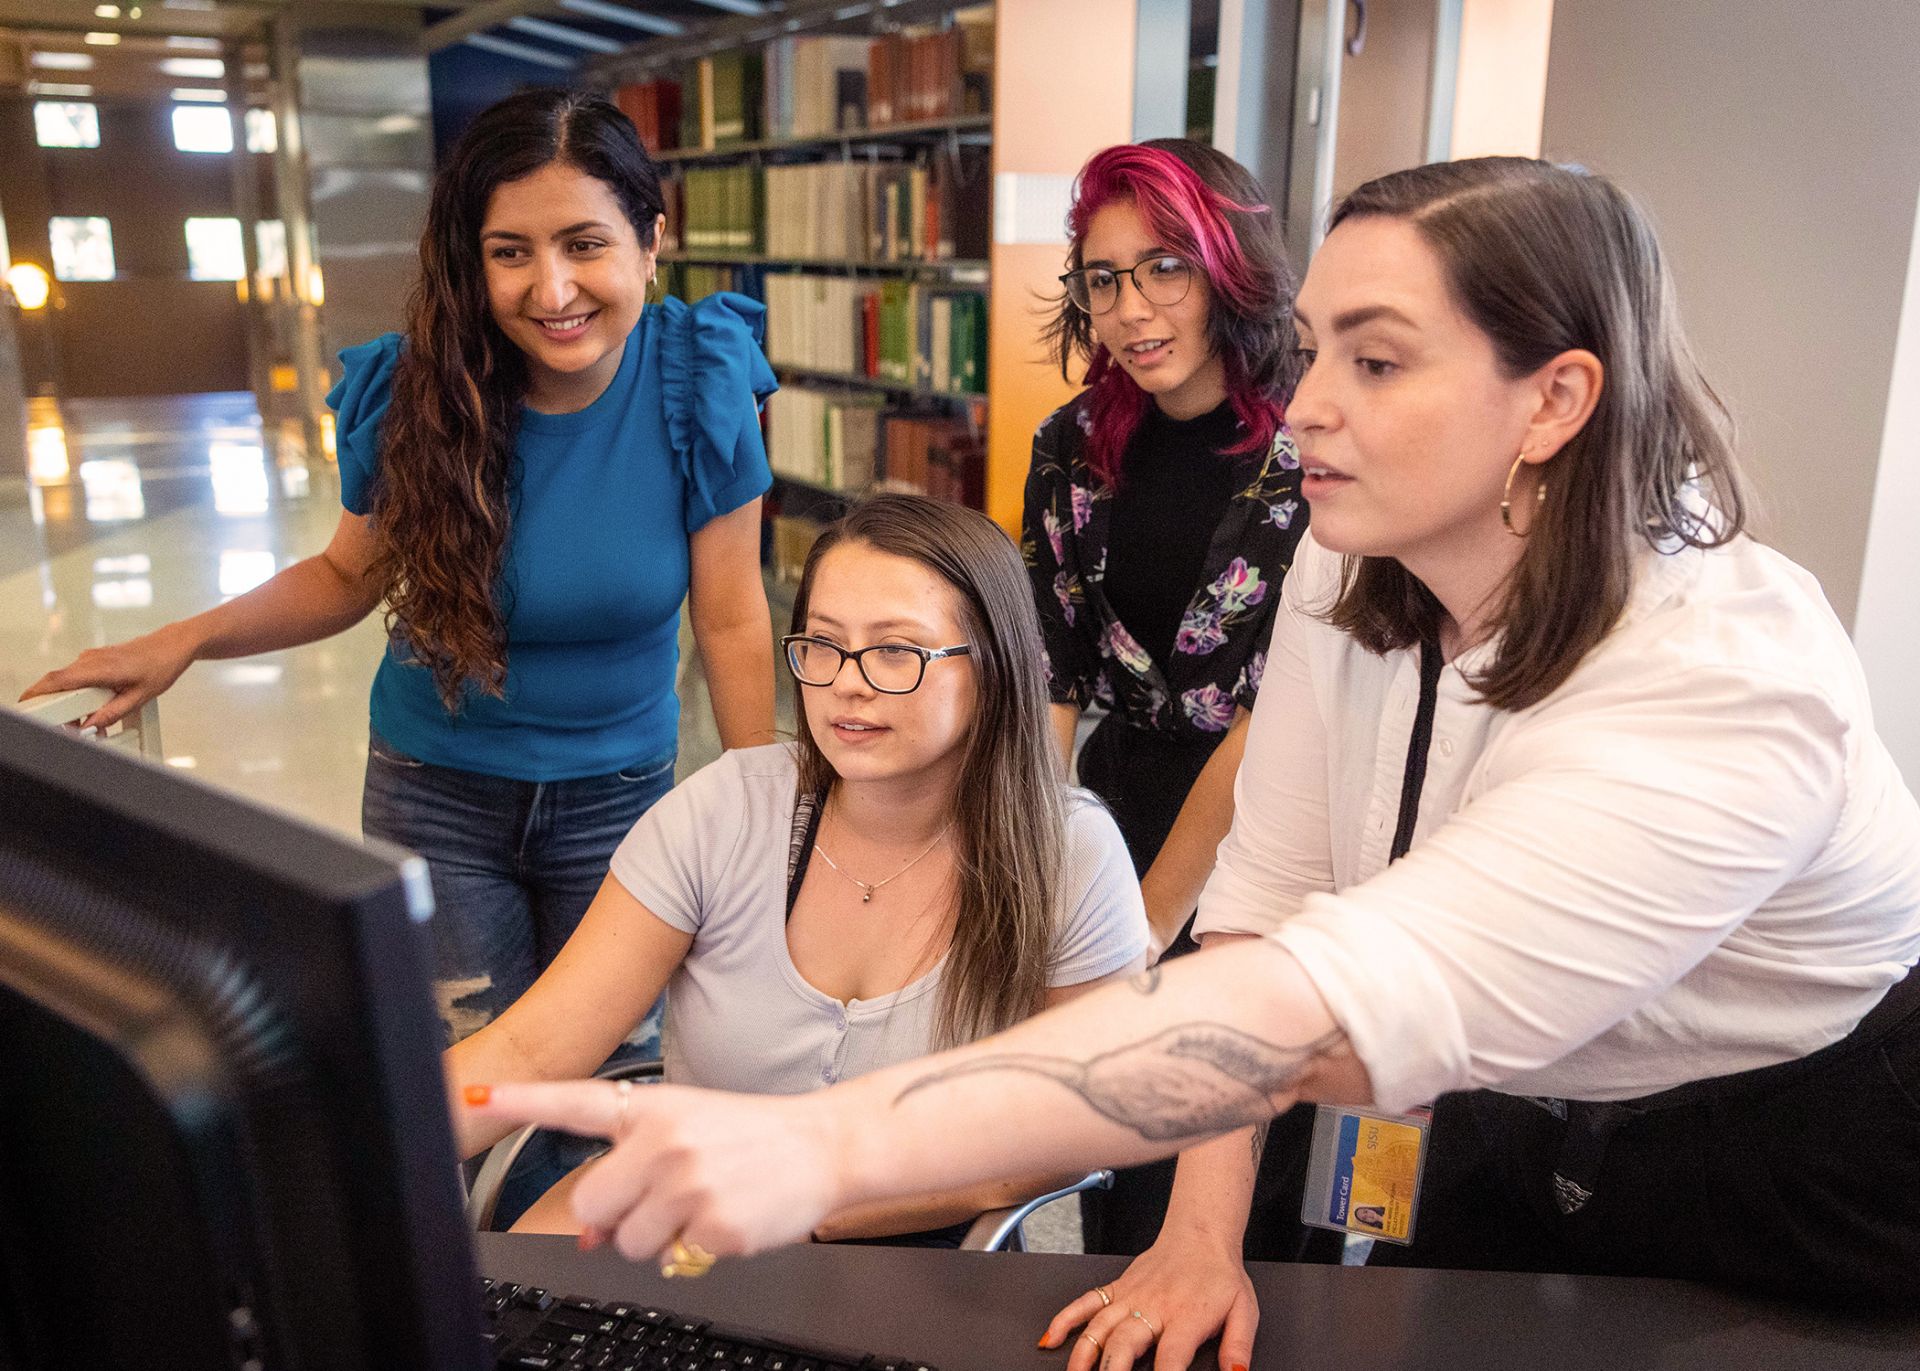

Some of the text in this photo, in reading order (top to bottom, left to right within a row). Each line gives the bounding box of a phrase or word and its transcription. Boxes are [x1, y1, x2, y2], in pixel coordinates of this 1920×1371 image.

[1367, 1127, 1379, 1150] SJSU
[1336, 1176, 1350, 1220] Tower Card
